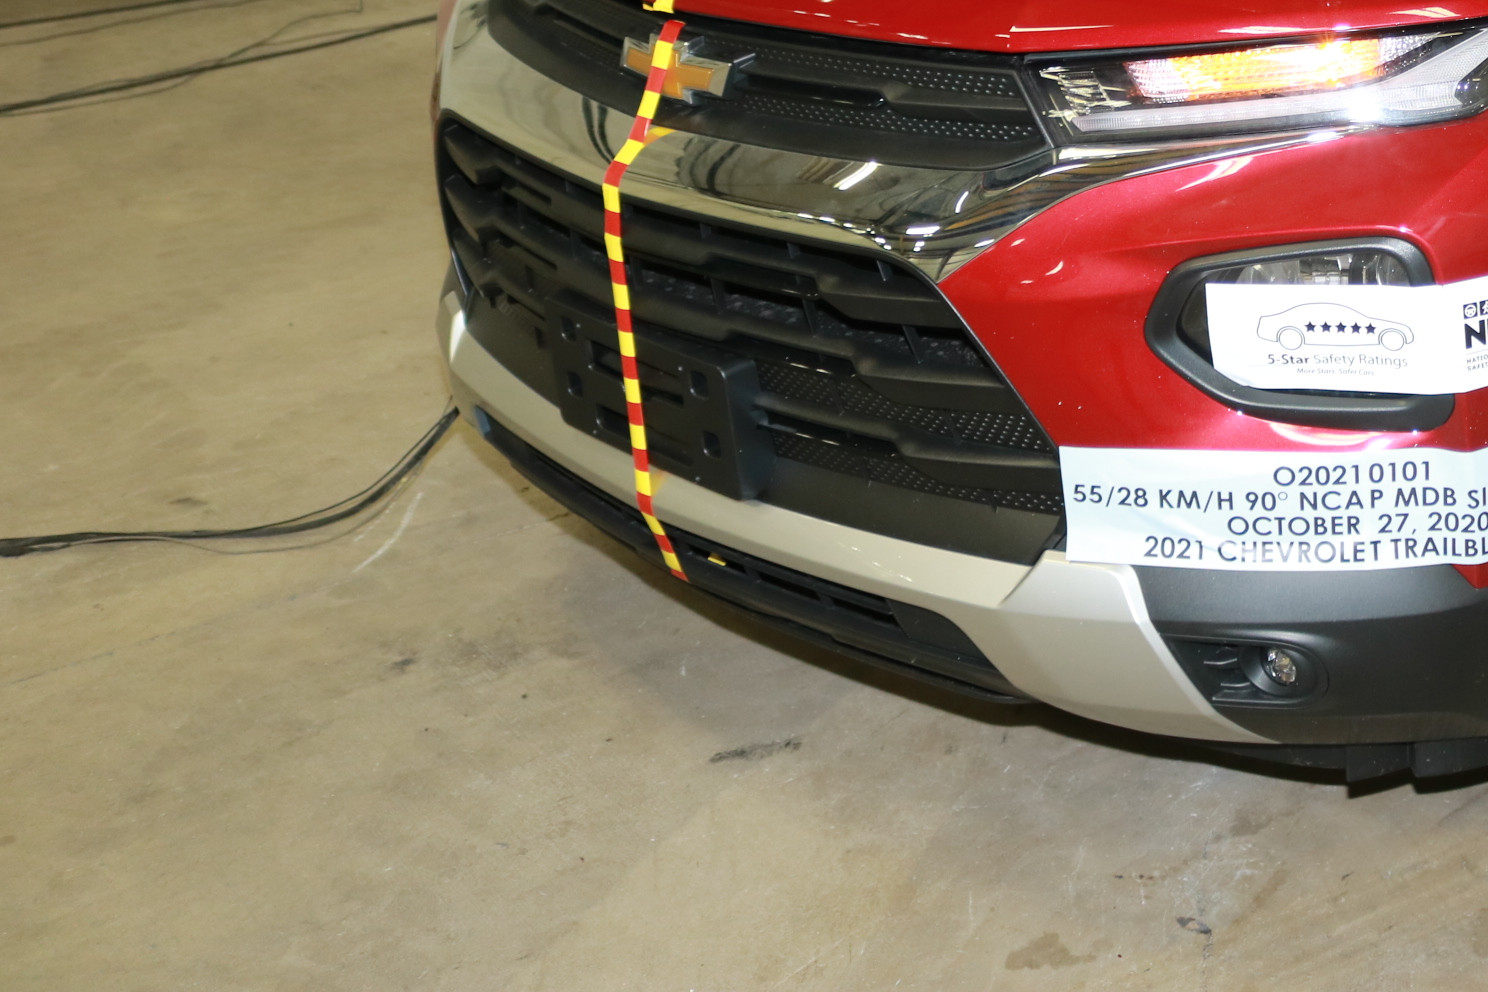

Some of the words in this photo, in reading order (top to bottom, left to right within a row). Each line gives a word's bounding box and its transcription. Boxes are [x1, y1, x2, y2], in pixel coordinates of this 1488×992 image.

[1267, 353, 1310, 365] 5-Star
[1313, 354, 1355, 367] Safety
[1358, 354, 1408, 369] Ratings
[1072, 484, 1149, 508] 55/28
[1158, 489, 1234, 513] KM/H
[1299, 489, 1384, 511] NCAP
[1394, 487, 1457, 508] MDB
[1227, 516, 1361, 536] OCTOBER
[1377, 513, 1417, 536] 27,
[1143, 535, 1203, 560] 2021
[1217, 540, 1382, 563] CHEVROLET
